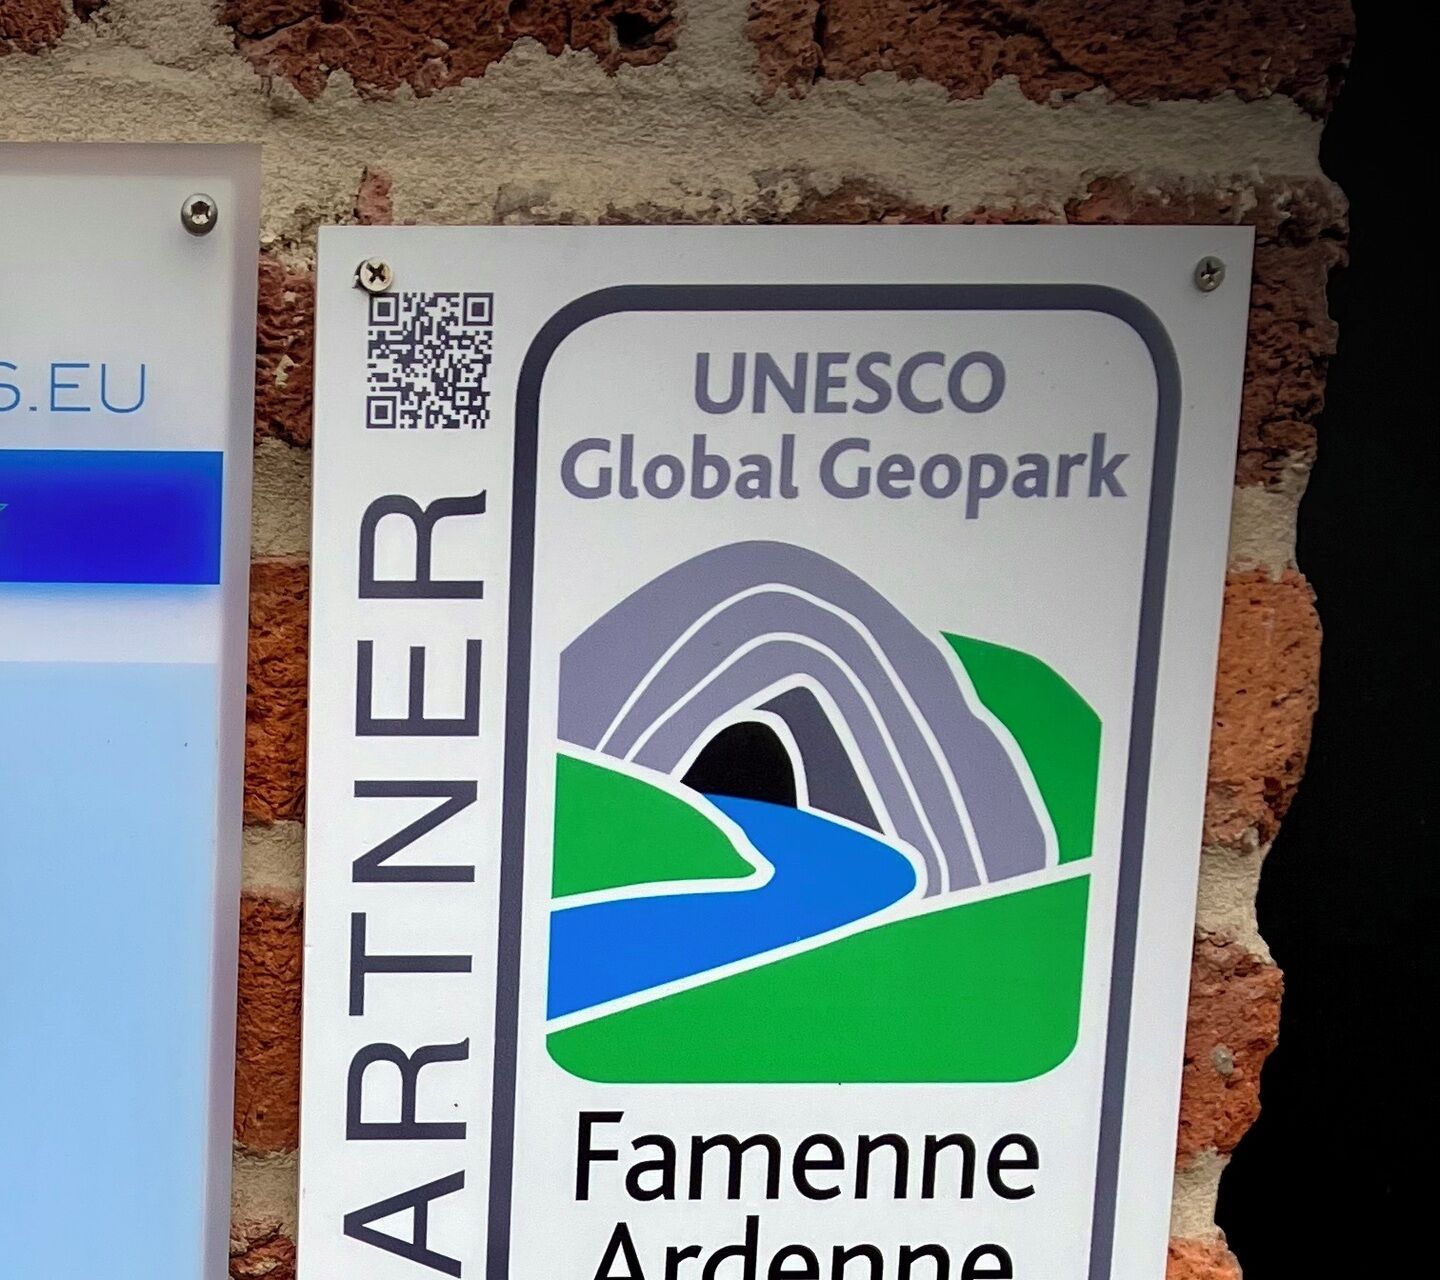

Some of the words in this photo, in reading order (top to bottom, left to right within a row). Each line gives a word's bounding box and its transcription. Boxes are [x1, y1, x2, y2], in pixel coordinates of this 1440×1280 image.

[694, 350, 1007, 415] UNESCO
[560, 433, 800, 500] Global
[819, 431, 1132, 520] Geopark
[575, 1110, 1040, 1202] Famenne
